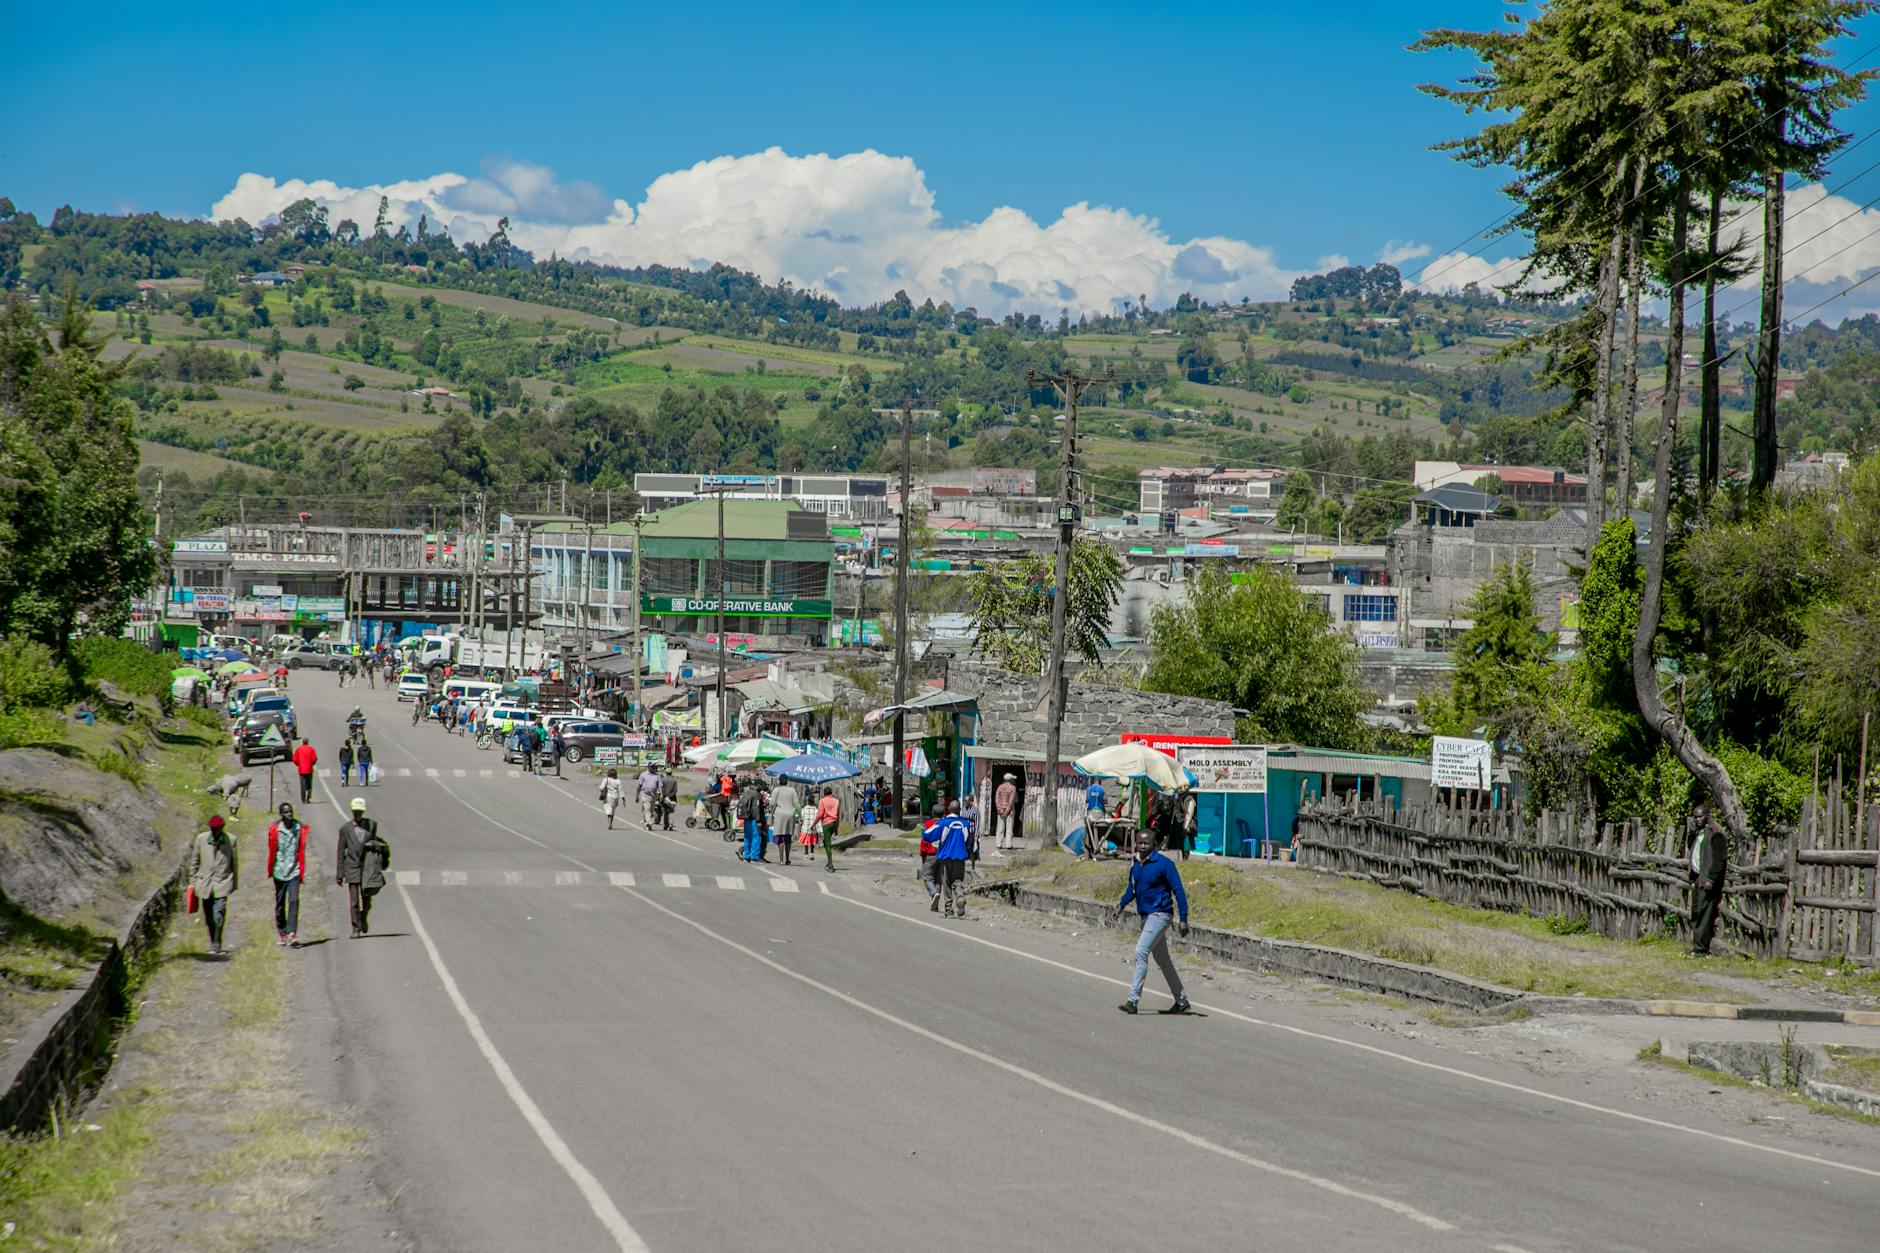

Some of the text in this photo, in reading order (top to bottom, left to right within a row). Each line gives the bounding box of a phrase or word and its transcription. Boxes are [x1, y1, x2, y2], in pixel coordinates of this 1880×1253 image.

[188, 543, 224, 551] PLAZA
[232, 552, 338, 563] T.M.C. PLAZA
[688, 600, 794, 612] CO-OPERATIVE BANK
[1437, 743, 1463, 752] CYBER
[795, 764, 837, 774] KING'S
